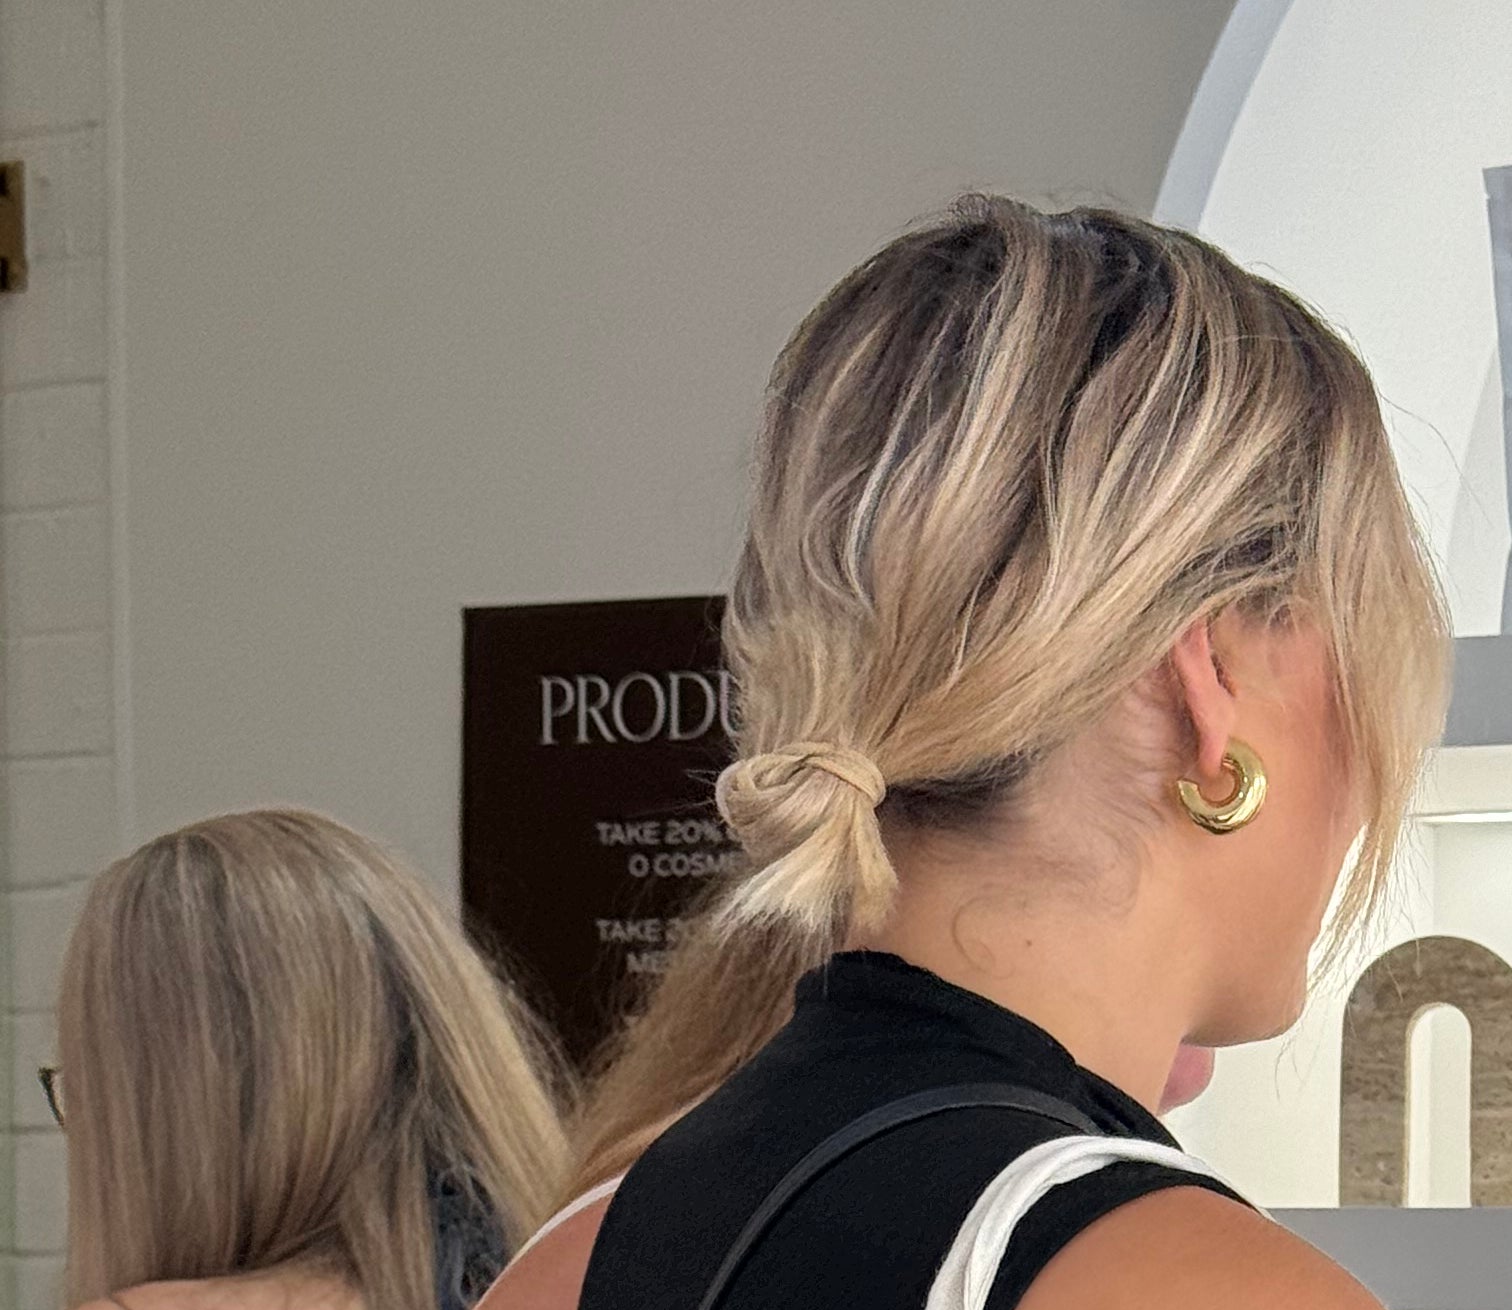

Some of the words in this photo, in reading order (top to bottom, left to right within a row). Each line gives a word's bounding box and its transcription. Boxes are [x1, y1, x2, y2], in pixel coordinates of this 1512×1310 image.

[540, 671, 738, 745] PRODU
[596, 821, 660, 845] TAKE
[628, 854, 649, 877] O
[596, 918, 661, 942] TAKE
